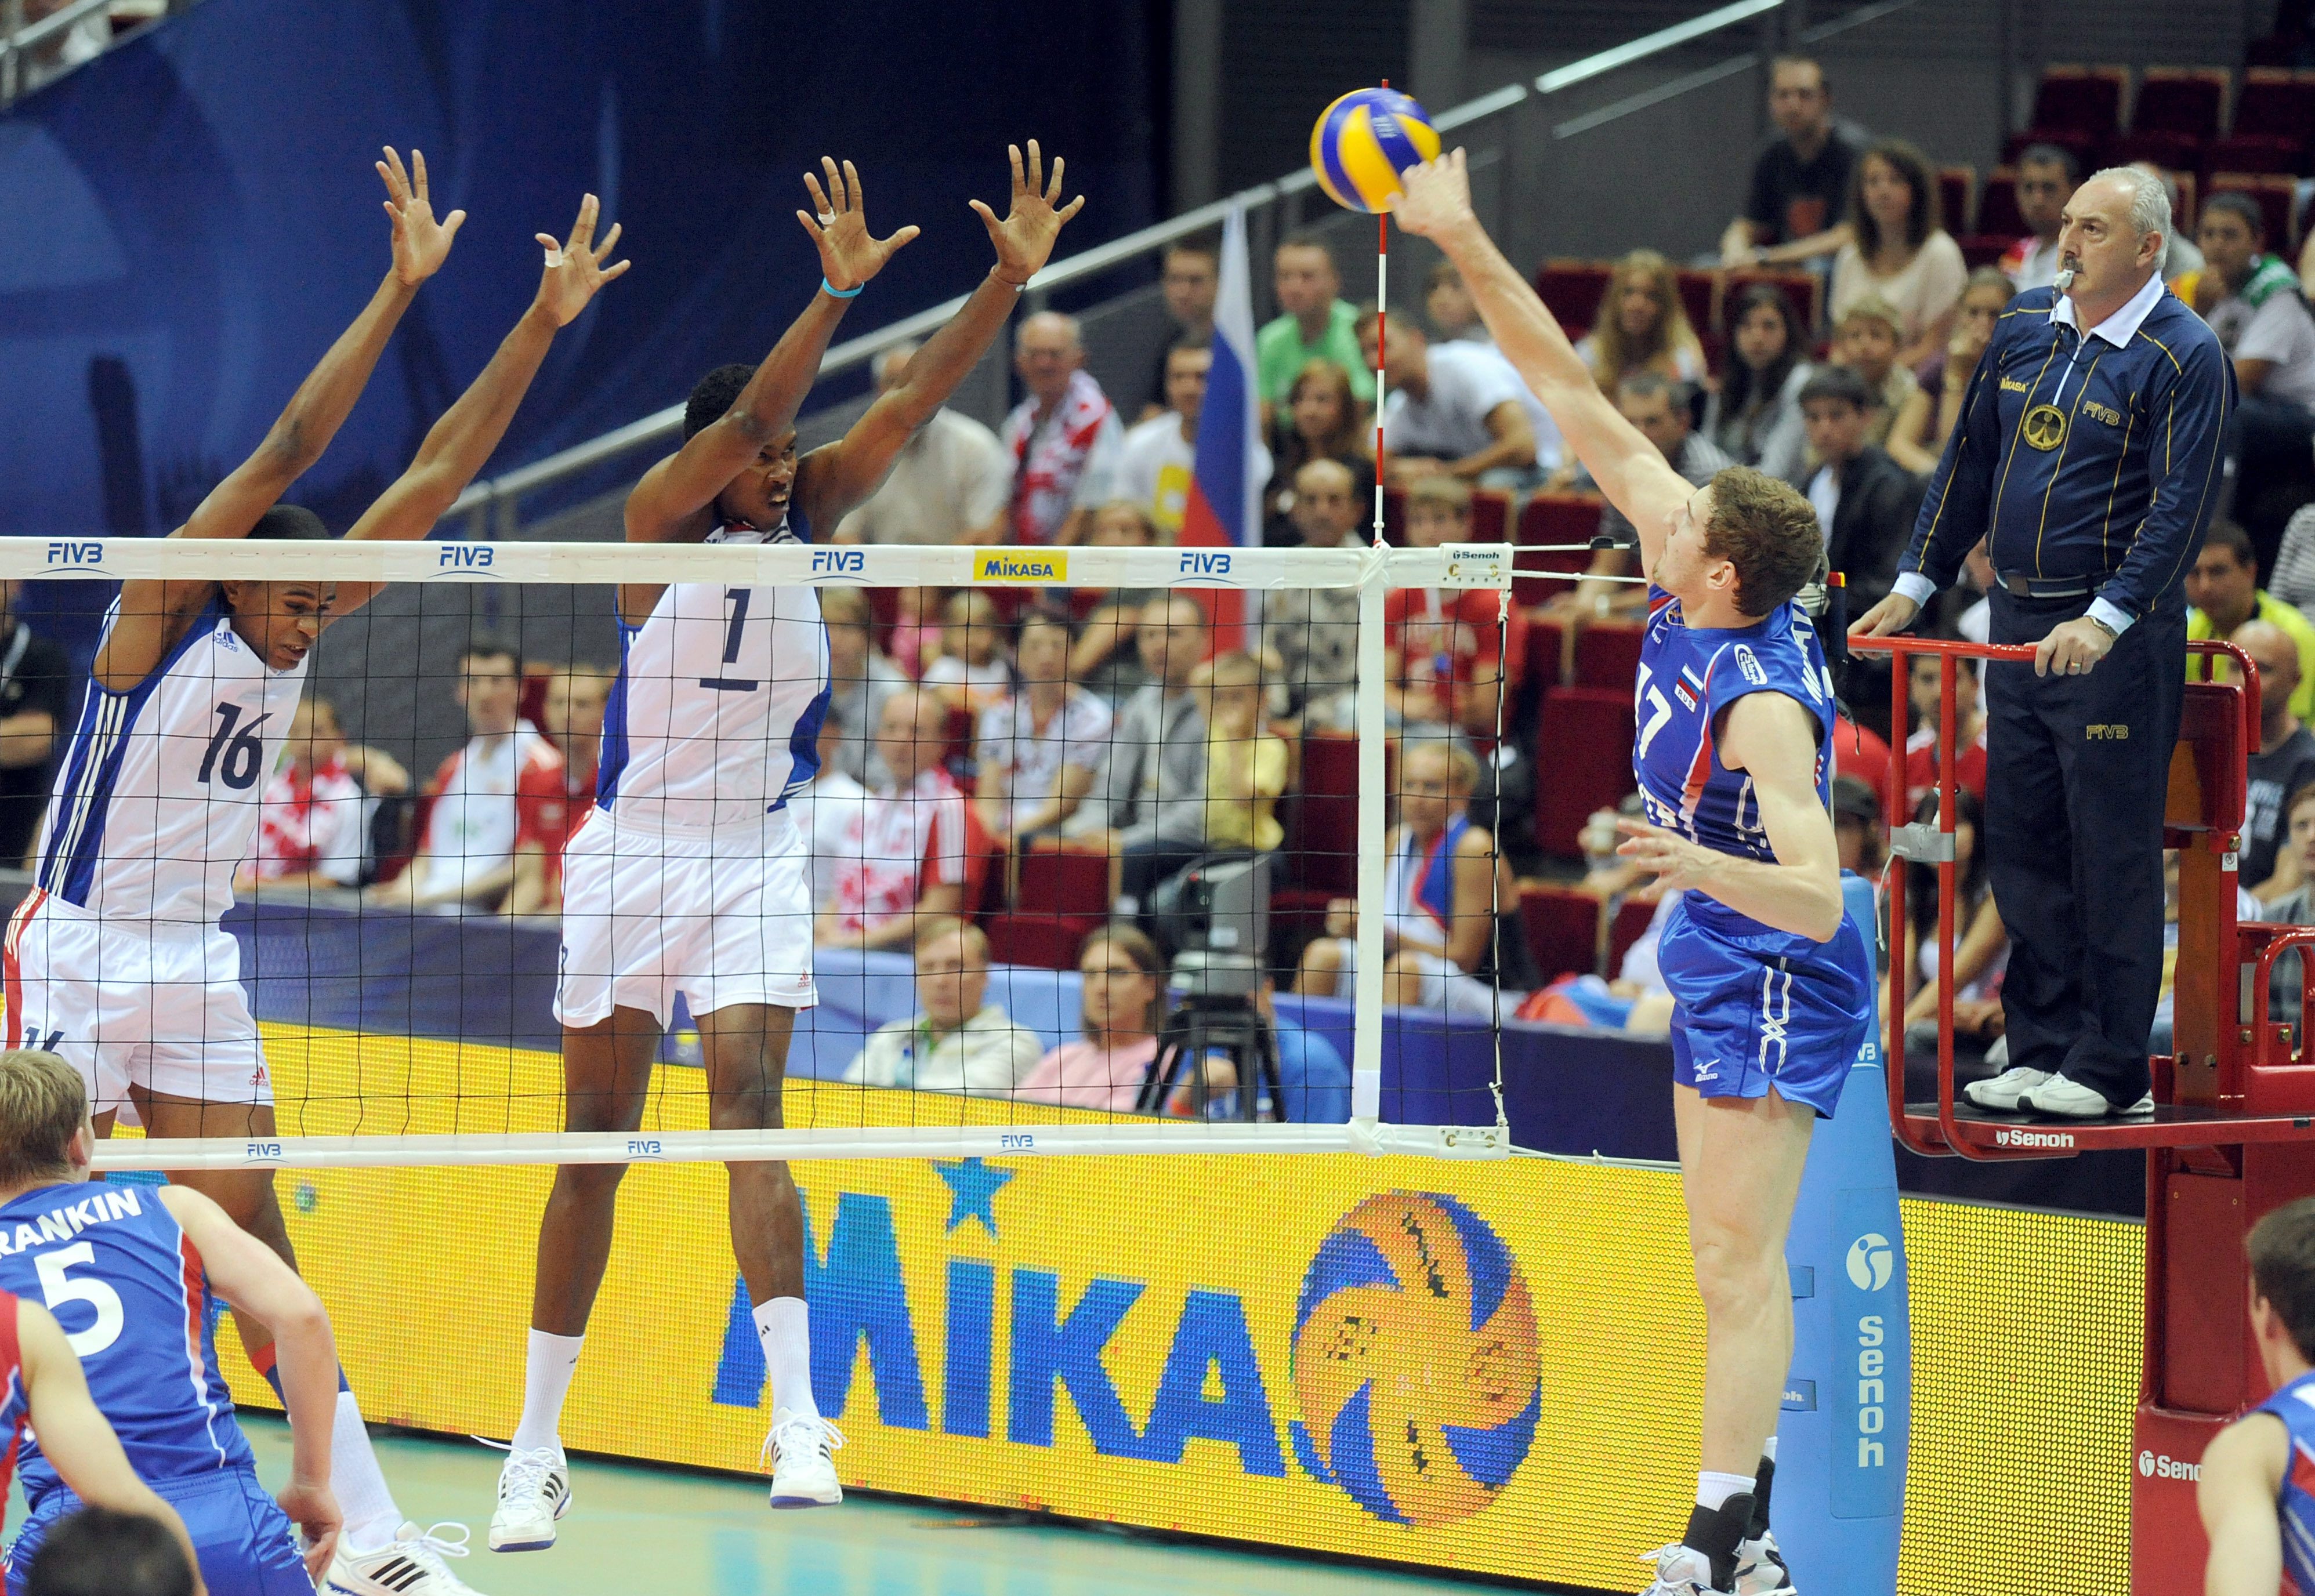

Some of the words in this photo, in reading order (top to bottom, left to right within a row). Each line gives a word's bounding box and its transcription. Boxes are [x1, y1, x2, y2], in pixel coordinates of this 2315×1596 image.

[2082, 400, 2120, 426] FIVB
[48, 542, 103, 564] FIVB
[439, 545, 494, 567] FIVB
[812, 551, 865, 571] FIVB
[1461, 551, 1499, 560] Senoh
[984, 556, 1054, 576] MIKASA
[1180, 553, 1231, 574] FIVB
[723, 588, 751, 663] 1
[213, 636, 238, 652] adidas
[1678, 688, 1693, 708] RUS
[2086, 724, 2129, 740] FIVB
[197, 701, 274, 790] 16
[628, 1140, 661, 1154] FIVB
[1001, 1134, 1034, 1147] FIVB
[2010, 1129, 2074, 1148] Senoh
[248, 1143, 281, 1157] FIVB
[34, 1241, 124, 1358] 5
[2157, 1454, 2203, 1482] Seno
